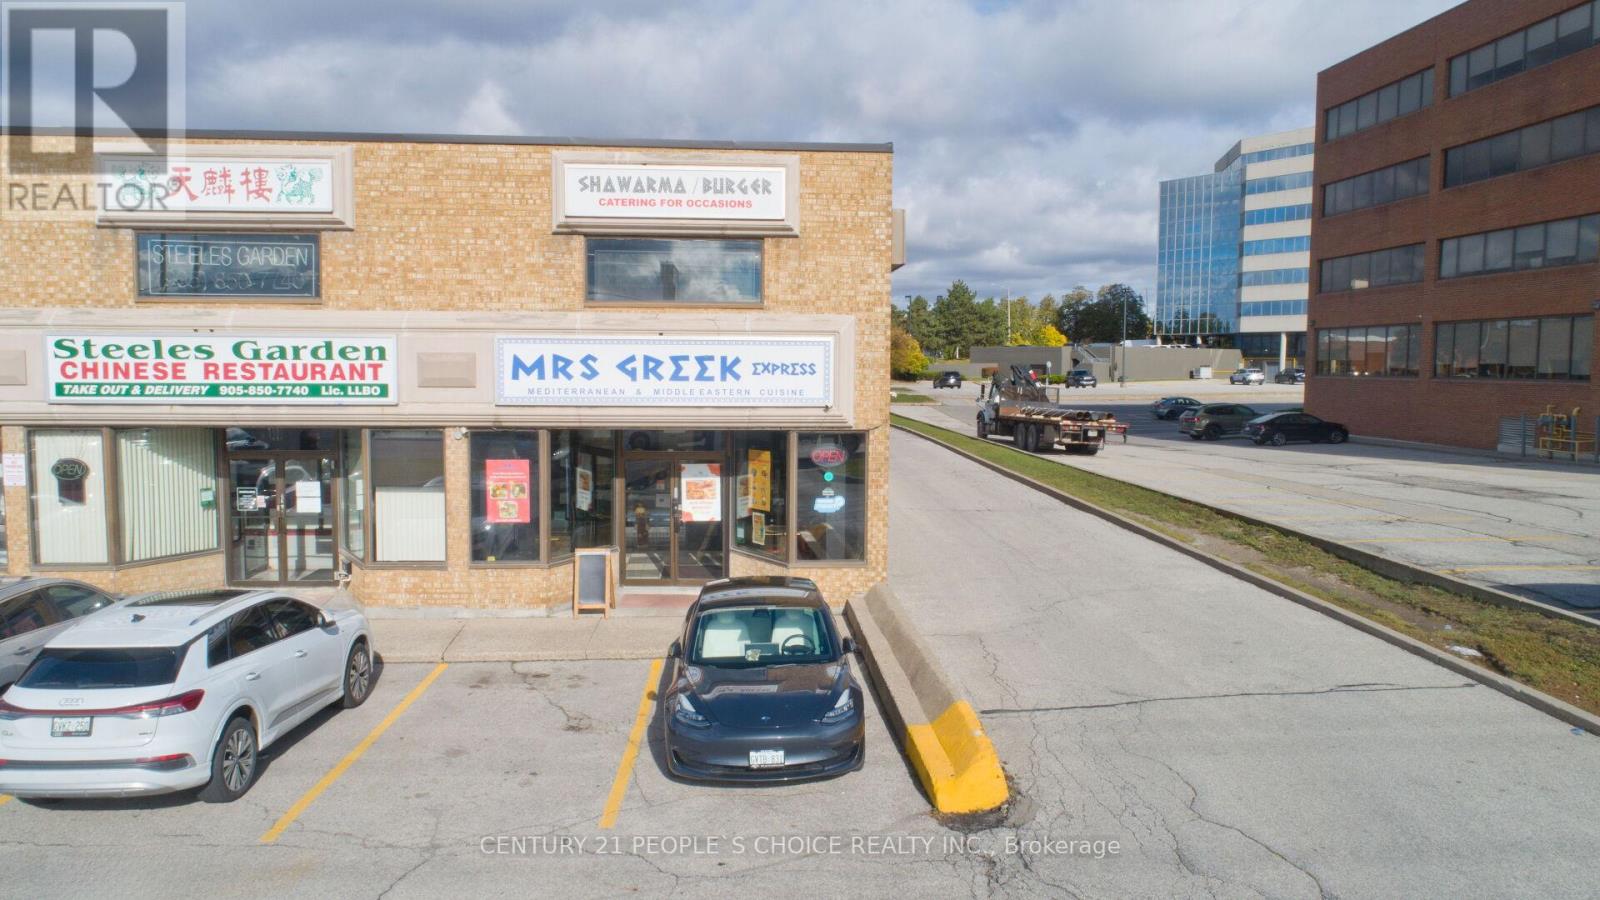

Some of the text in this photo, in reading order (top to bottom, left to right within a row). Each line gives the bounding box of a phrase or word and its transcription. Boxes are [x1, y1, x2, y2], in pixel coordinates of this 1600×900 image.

[578, 175, 686, 194] SHAWARMA
[702, 176, 772, 195] BURGER
[599, 197, 753, 209] CATERING FOR OCCASIONS
[152, 244, 308, 267] STEELES GARDEN
[53, 338, 387, 361] Steeles Garden
[60, 361, 383, 381] CHINESE RESTAURANT
[512, 353, 816, 382] MRS GREEK EXPRESS
[63, 385, 96, 395] TAKE
[100, 385, 129, 395] OUT
[131, 385, 142, 396] &
[145, 385, 209, 396] DELIVERY
[219, 386, 309, 396] 905-850-7740
[347, 386, 381, 396] LLBO
[528, 388, 625, 396] MEDITERRANEAN
[653, 388, 695, 396] MIDDLE
[699, 388, 751, 396] EASTERN
[759, 389, 805, 397] CUISINE
[55, 463, 83, 475] OPEN
